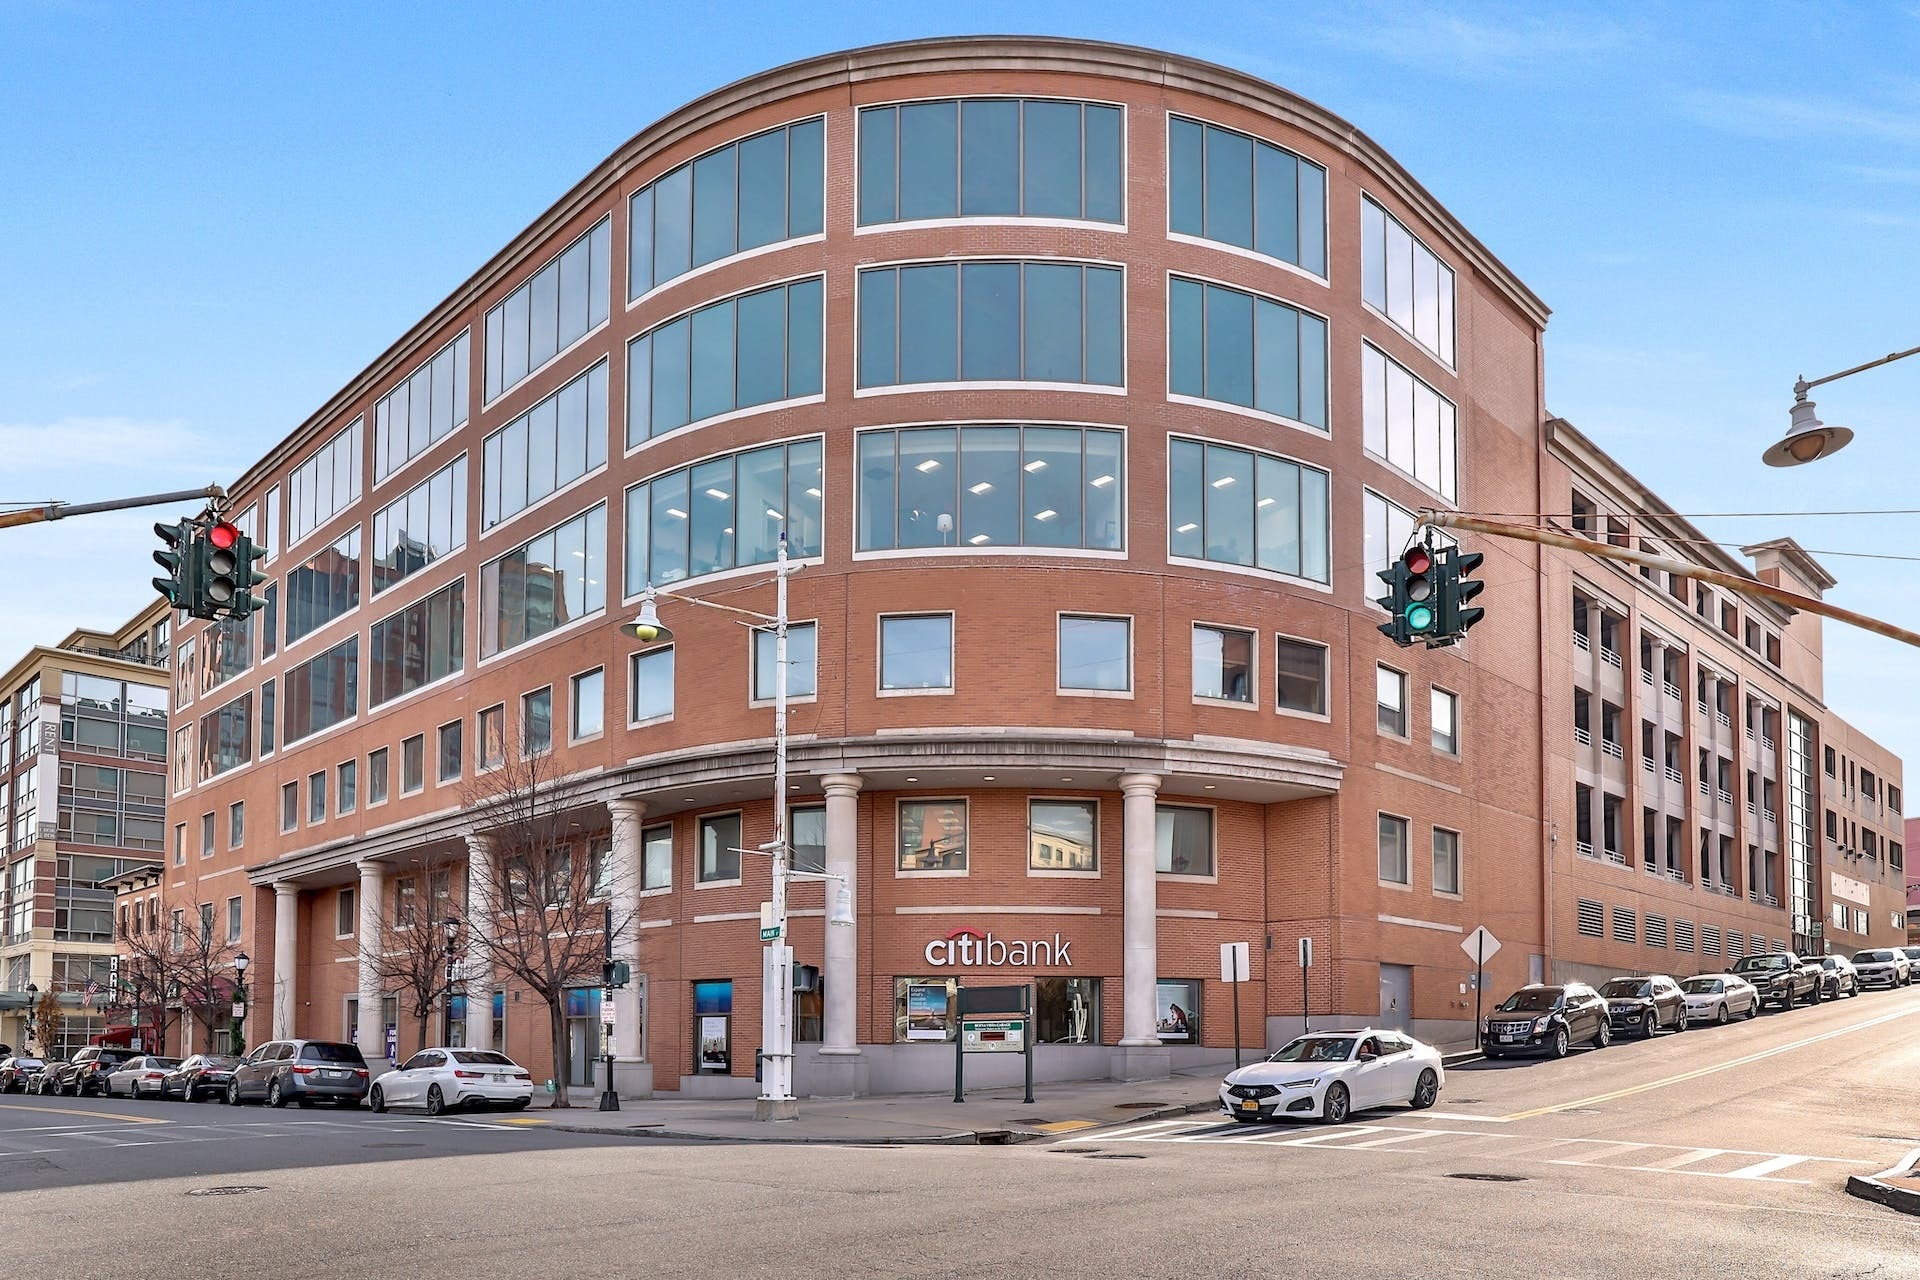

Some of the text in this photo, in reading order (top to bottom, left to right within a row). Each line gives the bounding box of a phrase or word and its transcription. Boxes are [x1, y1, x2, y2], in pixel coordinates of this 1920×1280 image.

[44, 724, 56, 754] RENT
[762, 930, 775, 938] MAIN
[925, 932, 1072, 966] citibank
[110, 956, 118, 1002] BAR
